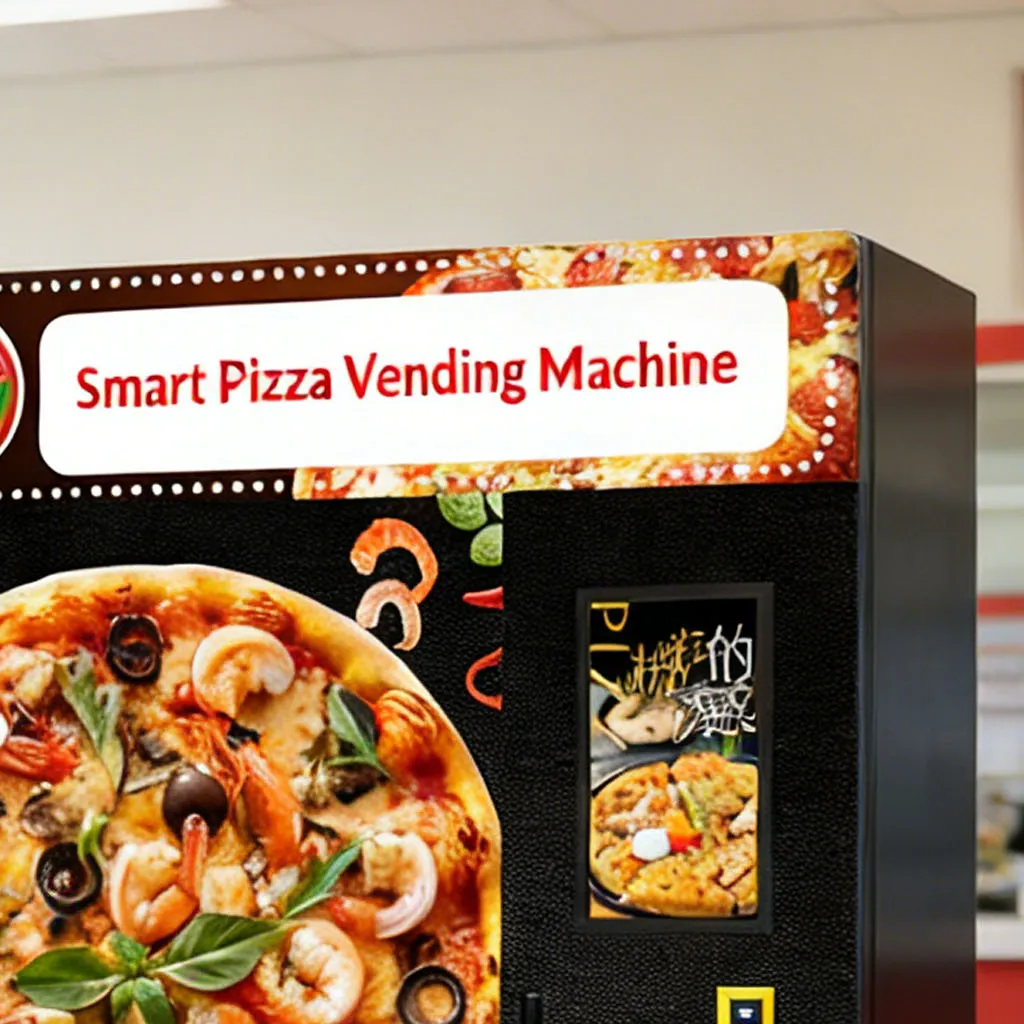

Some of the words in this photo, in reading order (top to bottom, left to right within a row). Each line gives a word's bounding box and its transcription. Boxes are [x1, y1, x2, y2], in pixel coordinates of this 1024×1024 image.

[76, 364, 207, 410] Smart
[219, 357, 332, 404] Pizza
[343, 347, 527, 405] Vending
[539, 340, 738, 392] Machine
